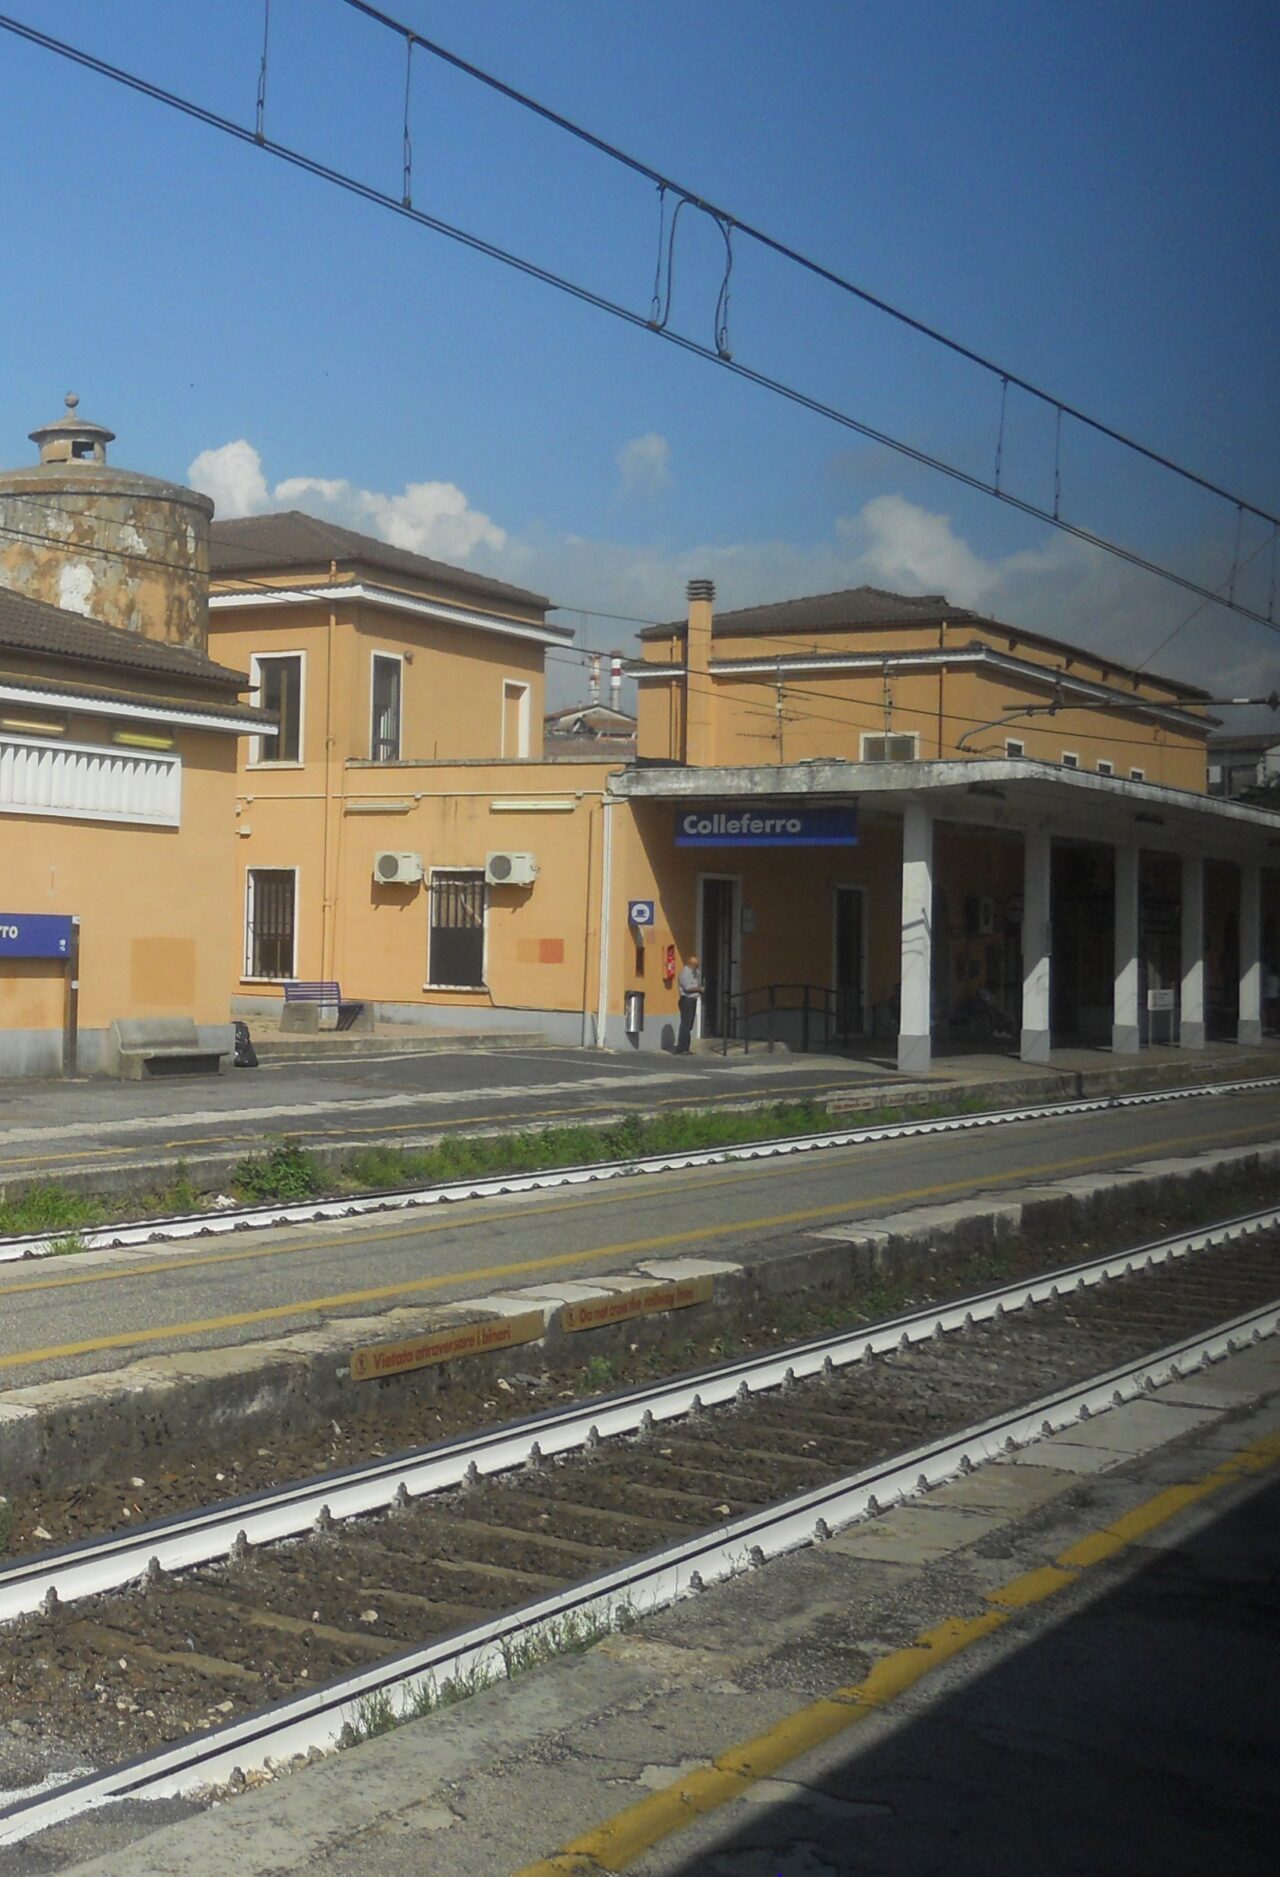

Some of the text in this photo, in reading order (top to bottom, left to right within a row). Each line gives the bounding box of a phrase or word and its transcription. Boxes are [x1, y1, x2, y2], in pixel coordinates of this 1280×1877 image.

[683, 813, 802, 835] Colleferro
[373, 1349, 414, 1370] Vietato
[415, 1335, 475, 1361] attraversare
[482, 1323, 512, 1345] binari
